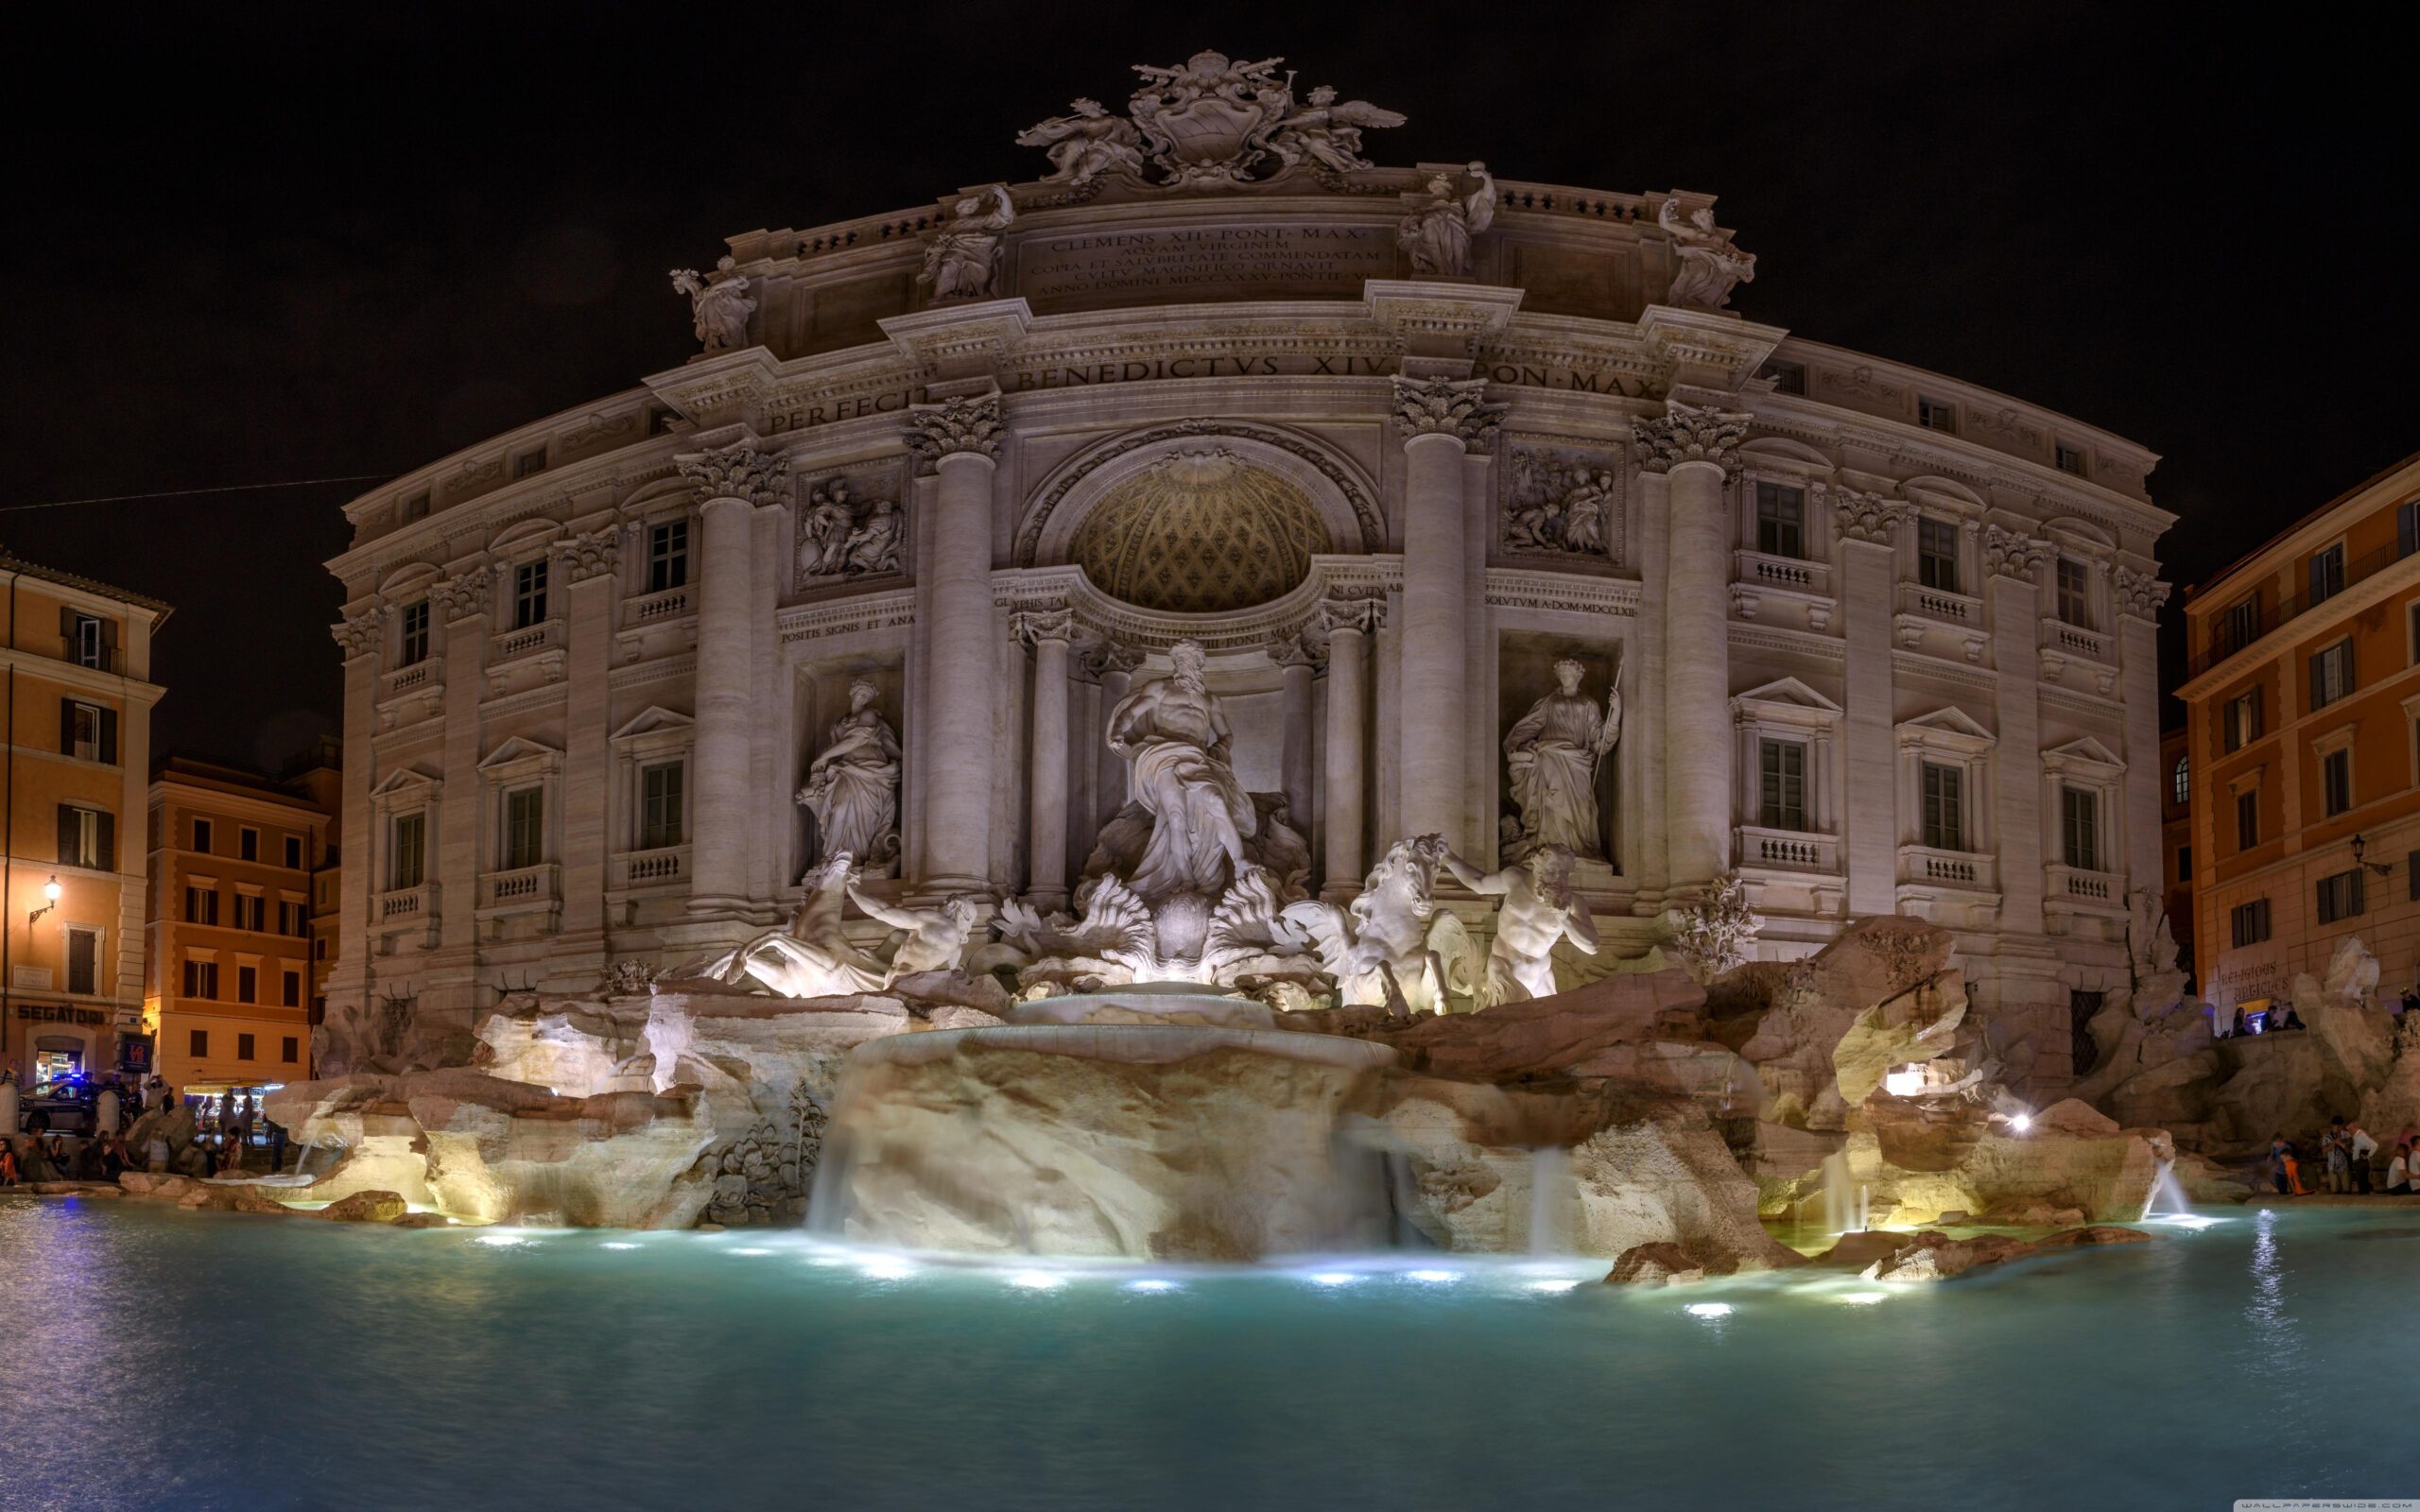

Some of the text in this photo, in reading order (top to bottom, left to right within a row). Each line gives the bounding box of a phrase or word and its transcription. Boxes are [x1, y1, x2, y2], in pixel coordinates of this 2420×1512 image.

[1051, 233, 1155, 251] CLEMENS
[1120, 241, 1288, 256] AQVAM VIRGINEM
[1090, 260, 1106, 269] ET
[1237, 250, 1379, 261] COMMENDATAM
[1254, 262, 1333, 270] ORNAVIT
[1037, 284, 1089, 296] ANNO
[1095, 278, 1159, 290] DOMINI
[770, 387, 929, 436] PERFECIT
[1018, 356, 1278, 388] BENEDICTVS
[1484, 595, 1538, 609] SOLVTVM
[781, 628, 821, 644] POSITIS
[825, 623, 860, 636] SIGNIS
[867, 620, 881, 630] ET
[2221, 961, 2276, 986] RELIGIOUS
[2234, 977, 2289, 999] ARTICLES
